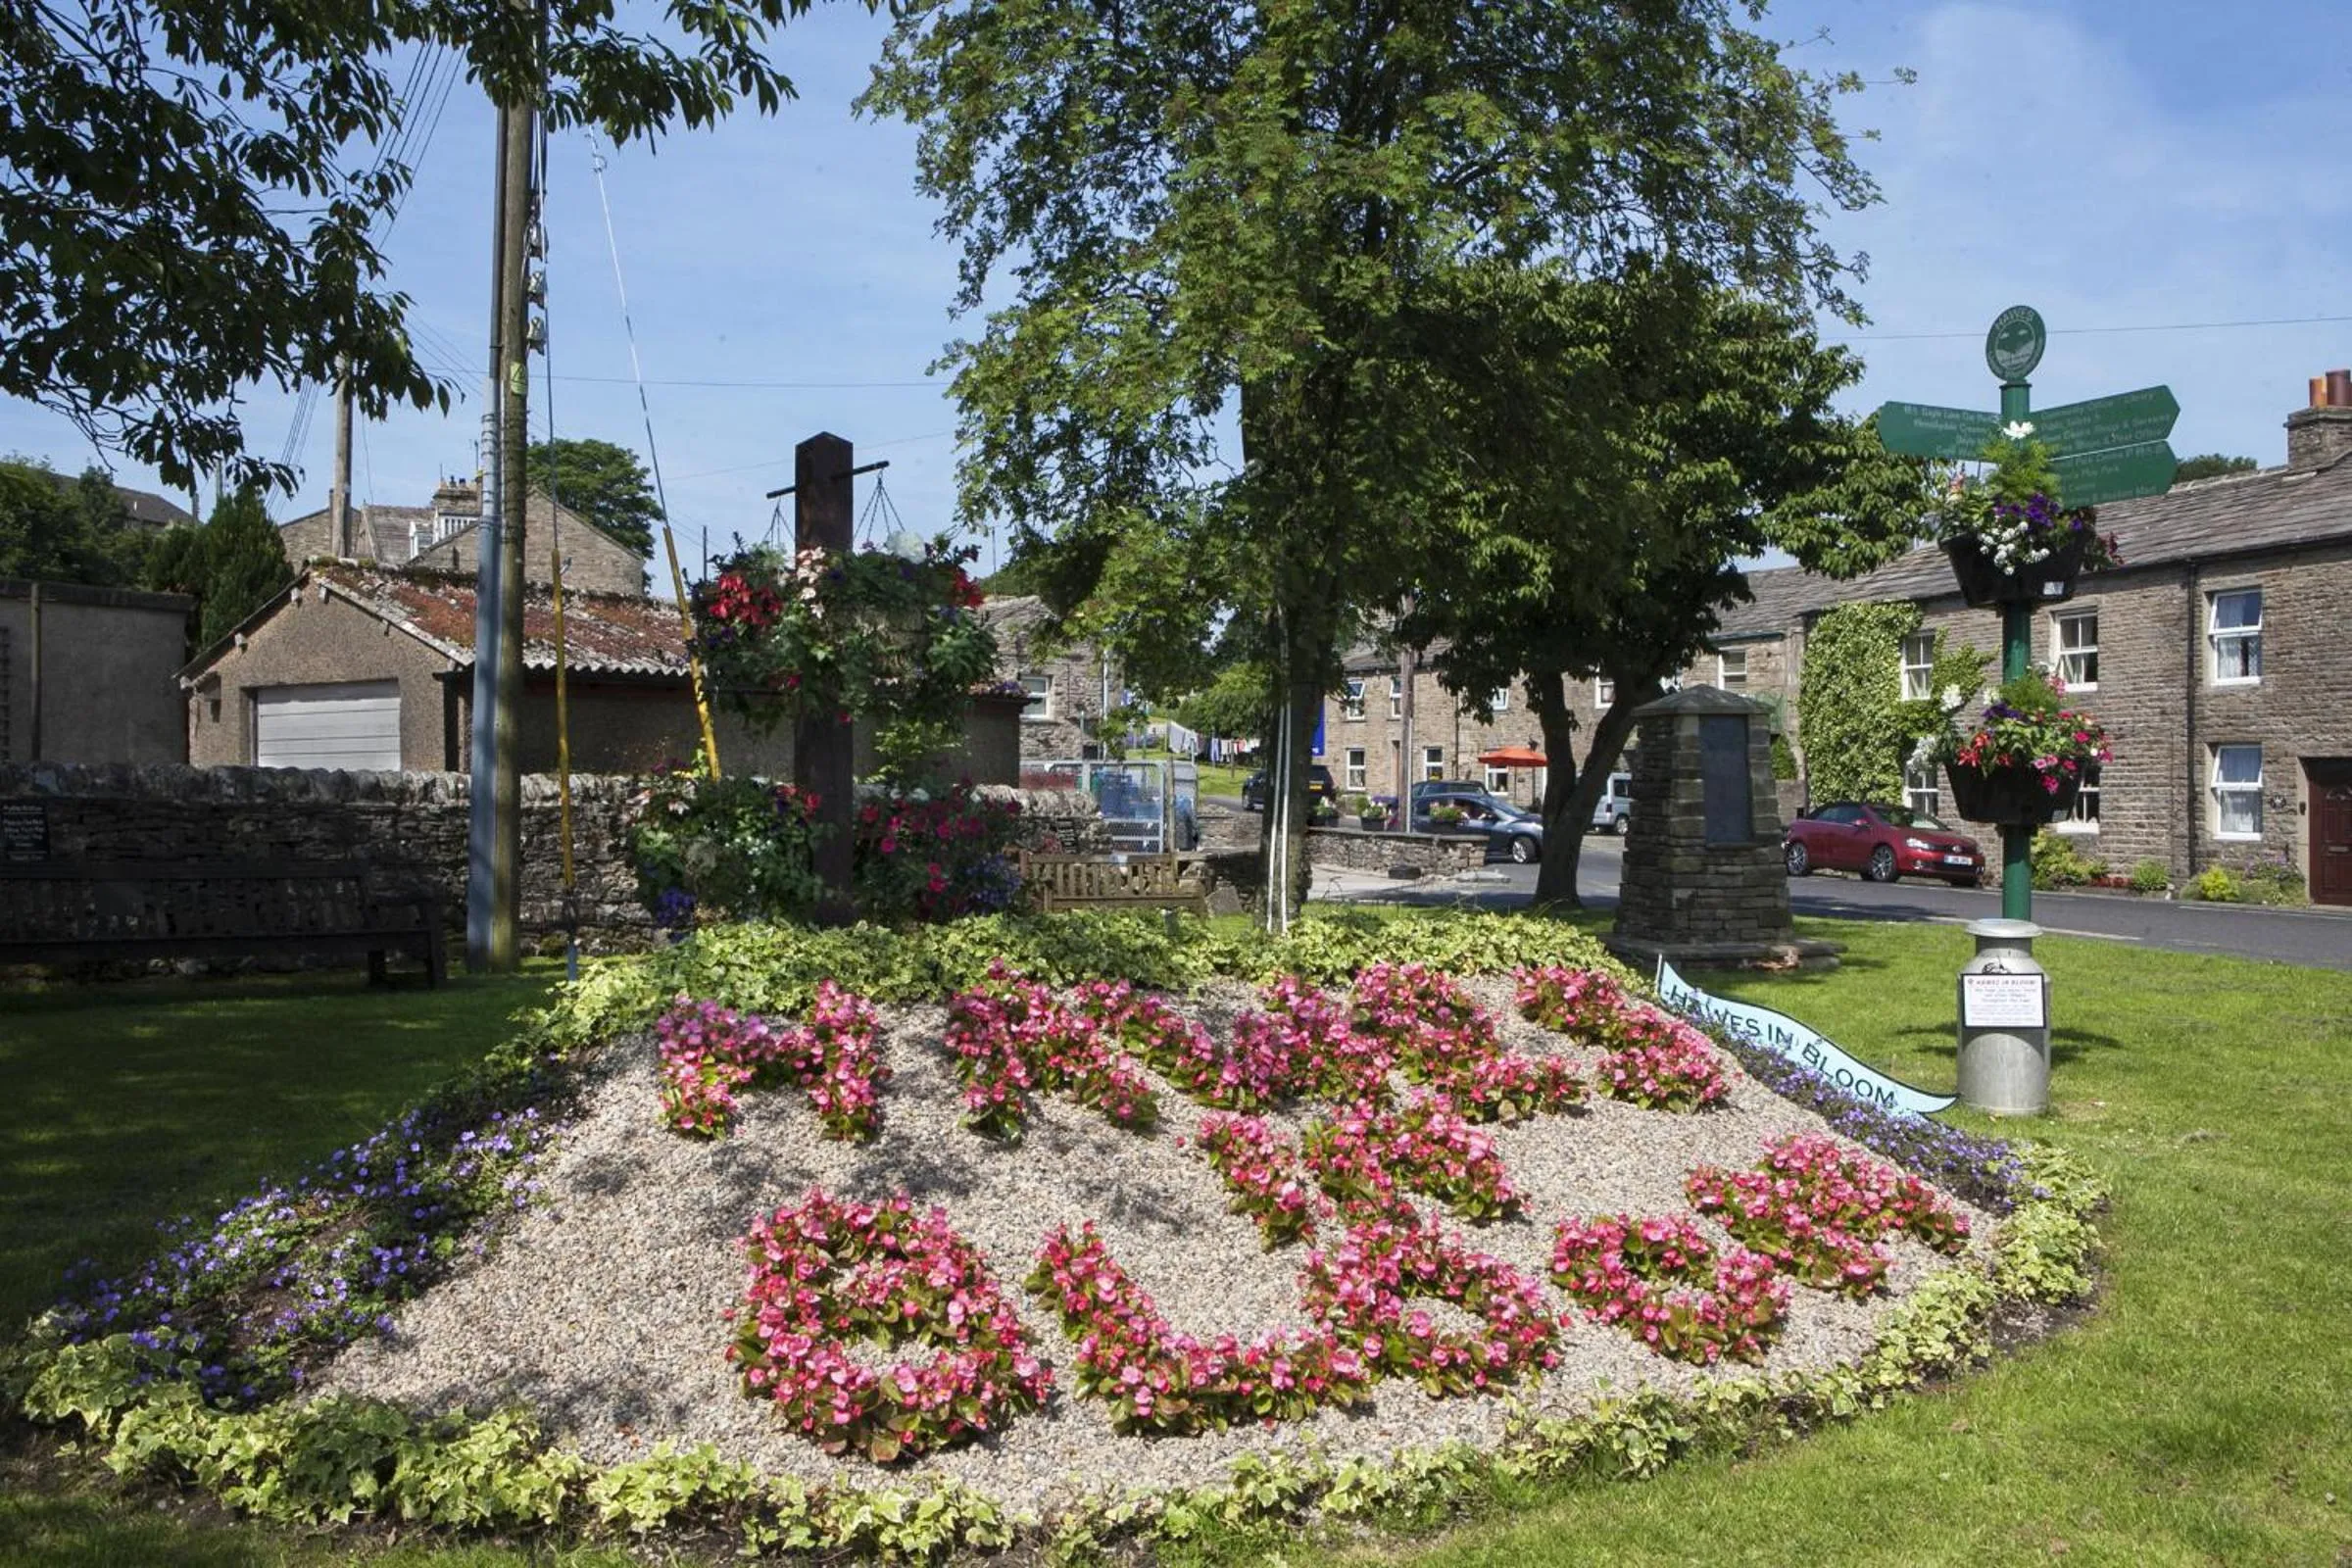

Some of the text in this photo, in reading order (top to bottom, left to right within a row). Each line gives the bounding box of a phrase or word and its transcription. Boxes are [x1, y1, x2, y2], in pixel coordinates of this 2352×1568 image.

[1670, 984, 1896, 1109] HWES IN BLOOM
